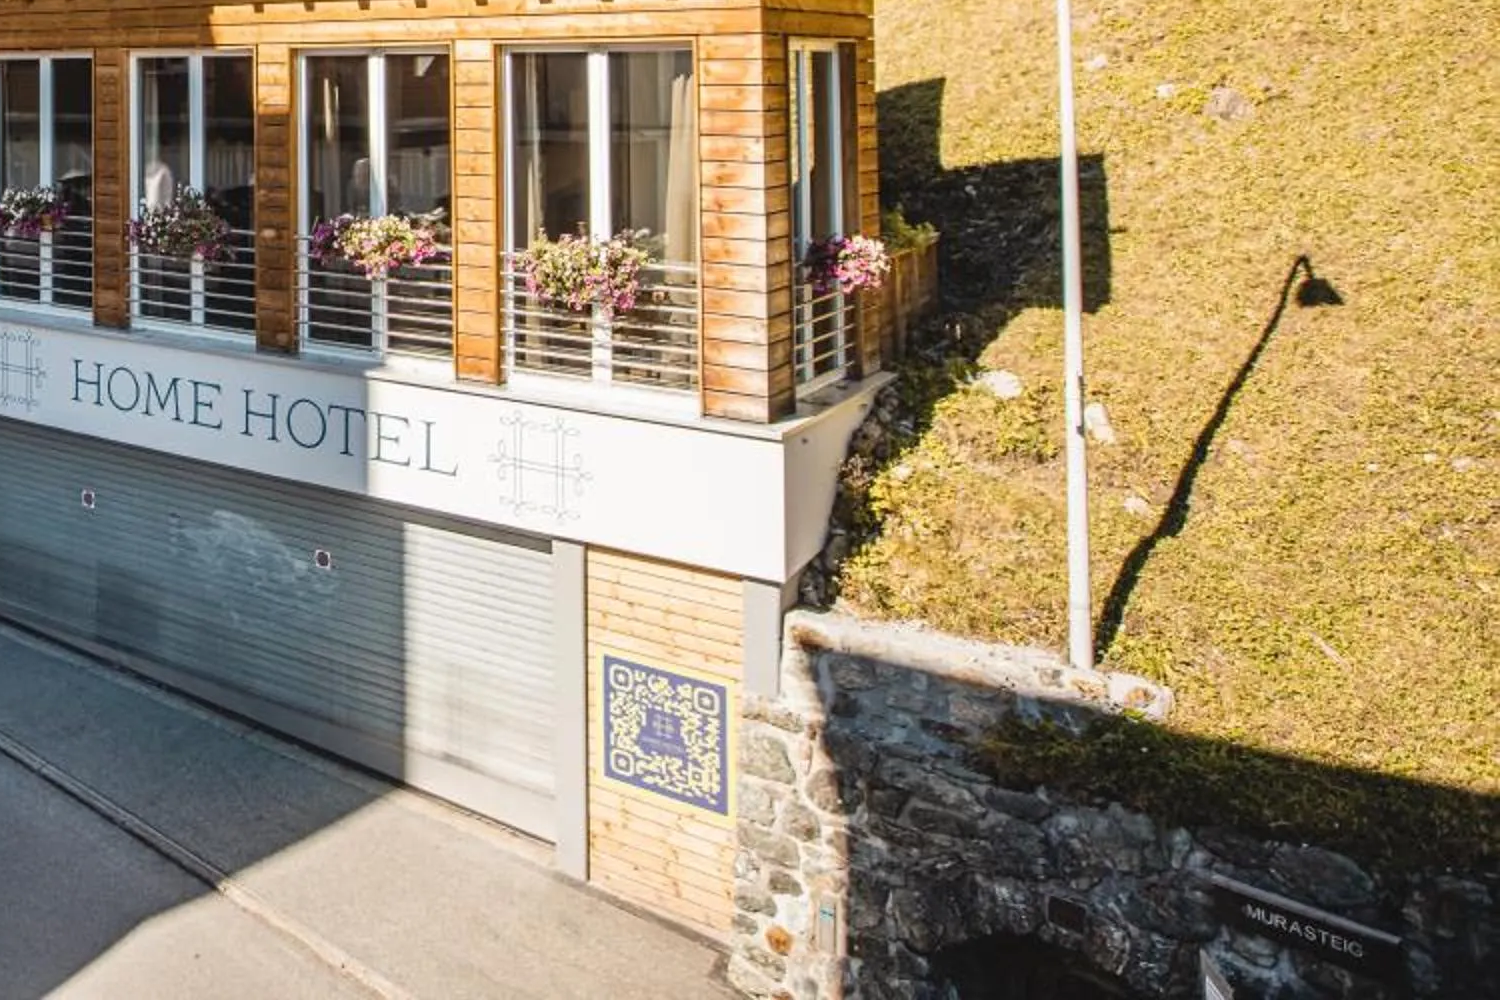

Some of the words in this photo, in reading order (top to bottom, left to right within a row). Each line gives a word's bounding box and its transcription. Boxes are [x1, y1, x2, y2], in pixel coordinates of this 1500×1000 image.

[71, 359, 223, 431] HOME
[241, 389, 459, 477] HOTEL
[1242, 904, 1364, 958] MURASTEIG
